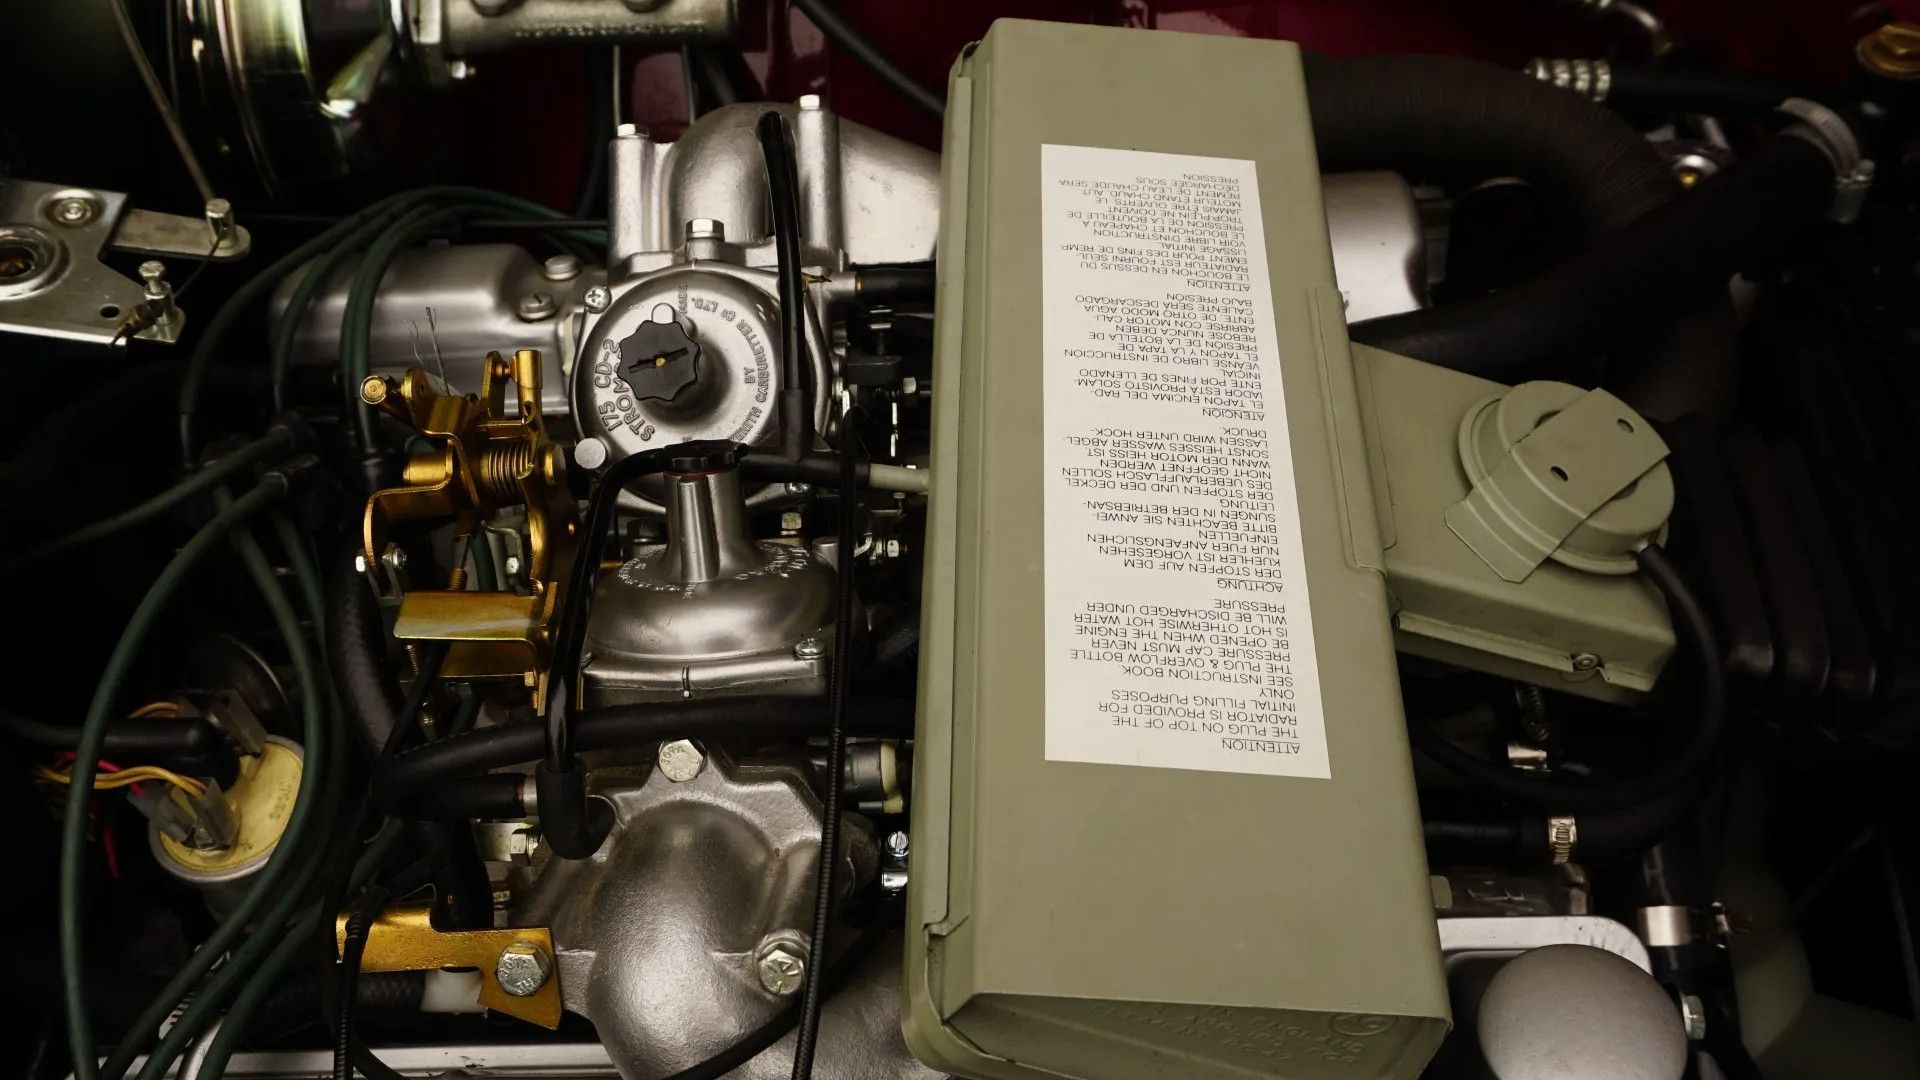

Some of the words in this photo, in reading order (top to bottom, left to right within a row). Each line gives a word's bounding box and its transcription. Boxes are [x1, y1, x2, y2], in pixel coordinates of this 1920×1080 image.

[1074, 294, 1159, 308] DESCARGADO
[1220, 296, 1252, 306] BAJO
[1083, 304, 1117, 314] AGUA
[1120, 307, 1159, 317] MODO
[1198, 303, 1253, 314] CALIENTE
[1162, 310, 1197, 319] OTRO
[1201, 312, 1217, 321] DE
[1126, 316, 1170, 326] MOTOR
[1174, 319, 1202, 329] CON
[1160, 327, 1204, 338] NUNCA
[1205, 322, 1256, 332] ABRIRSE
[1088, 331, 1105, 340] DE
[1107, 333, 1163, 344] BOTELLA
[1165, 337, 1181, 345] LA
[1207, 331, 1256, 341] REBOSE
[1117, 343, 1134, 351] DE
[1184, 338, 1202, 347] DE
[1137, 344, 1166, 353] TAPA
[1170, 346, 1185, 355] LA
[1188, 348, 1196, 356] Y
[1151, 354, 1169, 363] DE
[1171, 356, 1209, 366] LIBRO
[1243, 351, 1258, 360] EL
[594, 339, 621, 389] CD-2
[744, 366, 756, 384] BY
[1078, 368, 1137, 379] LLENADO
[1140, 372, 1157, 381] DE
[1160, 373, 1197, 384] FINES
[1199, 376, 1226, 386] POR
[1230, 378, 1262, 388] ENTE
[1090, 388, 1120, 397] RAD-
[1124, 381, 1186, 393] PROVISTO
[1123, 390, 1148, 399] DEL
[1151, 392, 1200, 403] ENCIMA
[1248, 399, 1264, 408] EL
[598, 401, 623, 432] 175
[1090, 427, 1132, 438] HOCK-
[1135, 430, 1179, 441] UNTER
[1182, 433, 1216, 443] WIRD
[1111, 439, 1166, 451] WASSER
[1218, 435, 1268, 447] LASSEN
[1108, 448, 1146, 459] HEISS
[1168, 443, 1223, 454] HEISSES
[1226, 447, 1269, 458] SONST
[1149, 451, 1198, 463] MOTOR
[1201, 455, 1228, 465] DER
[1231, 457, 1270, 468] WANN
[1099, 458, 1156, 470] WERDEN
[1061, 466, 1112, 478] SOLLEN
[1233, 467, 1271, 478] NICHT
[1063, 477, 1116, 489] DECKEL
[1119, 481, 1147, 491] DER
[1150, 483, 1179, 493] UND
[1245, 478, 1272, 489] DES
[1182, 485, 1243, 497] STOPFEN
[1246, 489, 1274, 500] DER
[1082, 499, 1168, 514] BETRIEBSAN-
[1171, 505, 1199, 516] DER
[1202, 508, 1216, 517] IN
[1219, 509, 1276, 521] SUNGEN
[1142, 514, 1163, 524] SIE
[1166, 516, 1238, 530] BEACHTEN
[1241, 521, 1277, 532] BITTE
[1087, 533, 1208, 550] ANFAENGSLICHEN
[1211, 541, 1247, 552] FUER
[1098, 545, 1192, 560] VORGESEHEN
[1250, 544, 1279, 554] NUR
[1195, 551, 1215, 562] IST
[1218, 553, 1281, 566] KUEHLER
[1123, 558, 1154, 569] DEM
[1157, 560, 1185, 571] AUF
[1188, 562, 1250, 576] STOPFEN
[1253, 567, 1282, 578] DER
[1216, 579, 1284, 592] ACHTUNG
[1086, 601, 1135, 614] UNDER
[1138, 605, 1230, 620] DISCHARGED
[1073, 612, 1120, 625] WATER
[1124, 616, 1153, 627] HOT
[1233, 611, 1252, 622] BE
[1255, 613, 1287, 624] WILL
[1158, 618, 1239, 633] OTHERWISE
[1244, 623, 1272, 635] HOT
[1274, 625, 1288, 636] IS
[1075, 625, 1127, 638] ENGINE
[1131, 628, 1158, 640] THE
[1162, 630, 1205, 643] WHEN
[1090, 638, 1137, 651] NEVER
[1208, 633, 1267, 647] OPENED
[1271, 637, 1289, 648] BE
[1140, 641, 1180, 654] MUST
[1184, 644, 1213, 656] CAP
[1069, 649, 1123, 662] BOTTLE
[1217, 646, 1290, 661] PRESSURE
[1126, 652, 1205, 667] OVERFLOW
[1208, 658, 1219, 668] &
[1222, 659, 1261, 671] PLUG
[1264, 661, 1292, 673] THE
[1167, 668, 1262, 684] INSTRUCTION
[1266, 674, 1293, 686] SEE
[1111, 689, 1188, 704] PURPOSES
[1257, 686, 1295, 699] ONLY
[1192, 694, 1246, 708] FILLING
[1249, 698, 1296, 711] INITIAL
[1098, 701, 1128, 714] FOR
[1132, 704, 1205, 718] PROVIDED
[1208, 708, 1222, 720] IS
[1226, 710, 1297, 724] RADIATOR
[1111, 715, 1139, 728] THE
[1143, 718, 1164, 729] OF
[1167, 719, 1198, 731] TOP
[1201, 721, 1224, 733] ON
[1227, 723, 1266, 736] PLUG
[1270, 726, 1299, 738] THE
[1221, 738, 1301, 754] ATTENTION
